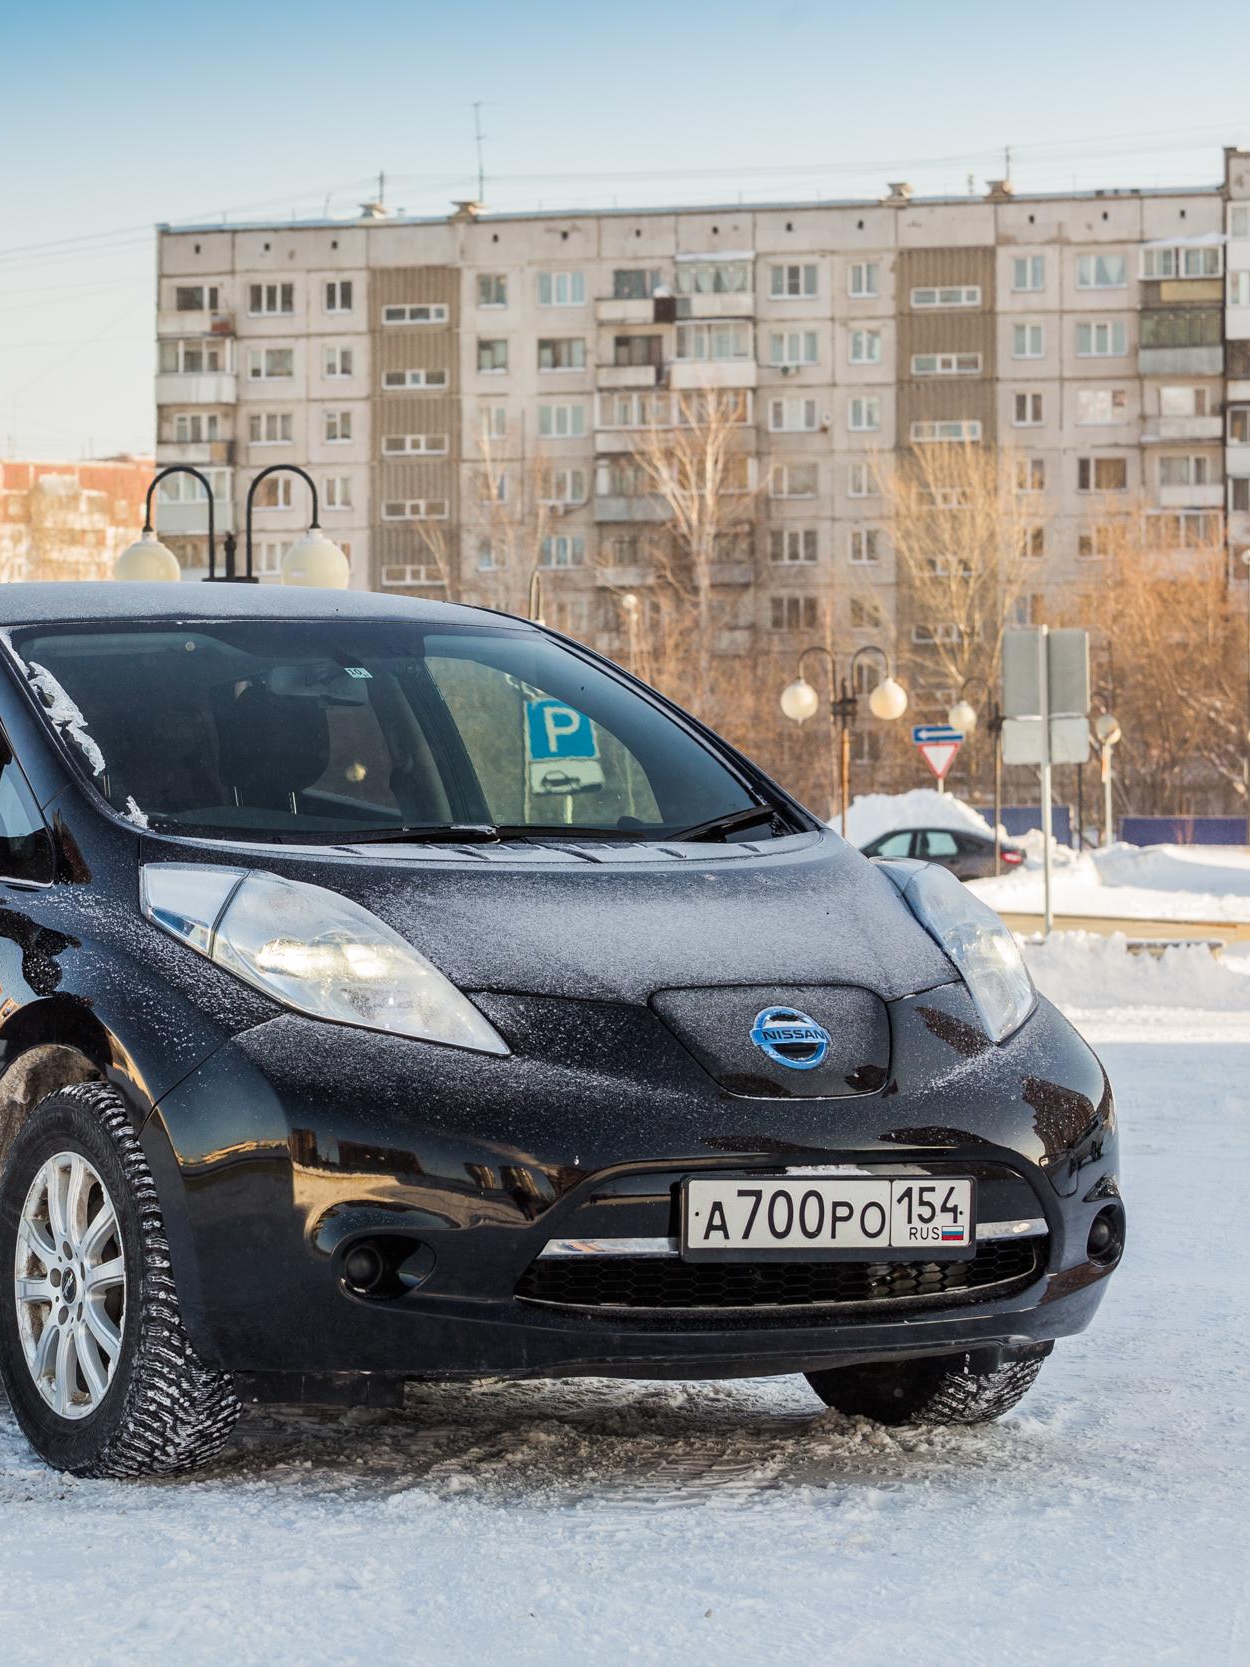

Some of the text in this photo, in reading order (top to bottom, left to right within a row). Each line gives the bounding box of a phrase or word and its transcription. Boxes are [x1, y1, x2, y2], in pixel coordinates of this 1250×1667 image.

[543, 706, 581, 753] P
[762, 1029, 828, 1041] NISSAN
[896, 1186, 959, 1225] 154
[908, 1226, 940, 1240] RUS
